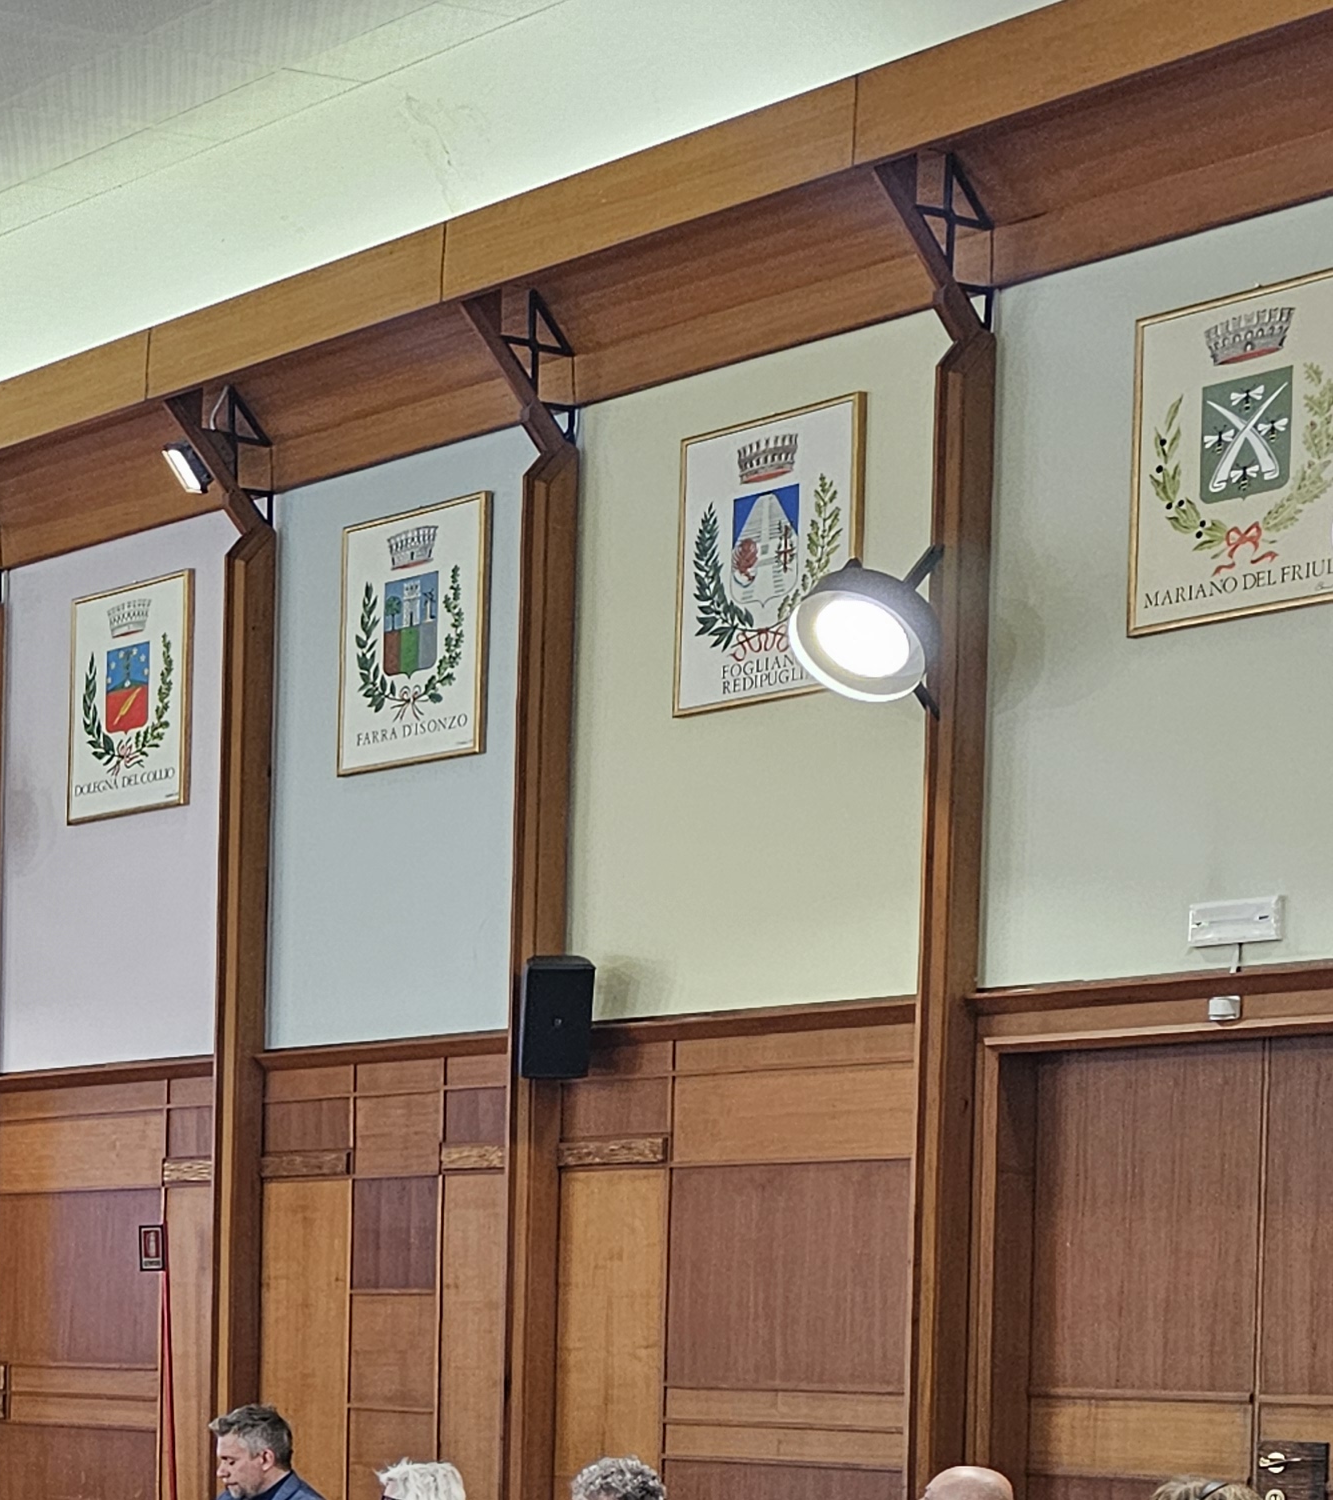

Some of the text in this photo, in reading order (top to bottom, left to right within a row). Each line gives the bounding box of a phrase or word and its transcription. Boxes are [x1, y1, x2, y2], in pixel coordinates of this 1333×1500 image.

[1144, 558, 1333, 609] MARIANO DEL FRIUL
[722, 655, 796, 679] FOGLIAN
[722, 667, 808, 694] REDIPUGLI
[357, 727, 397, 746] FARRA
[75, 767, 175, 797] DOLEGNA DEL COLLIO
